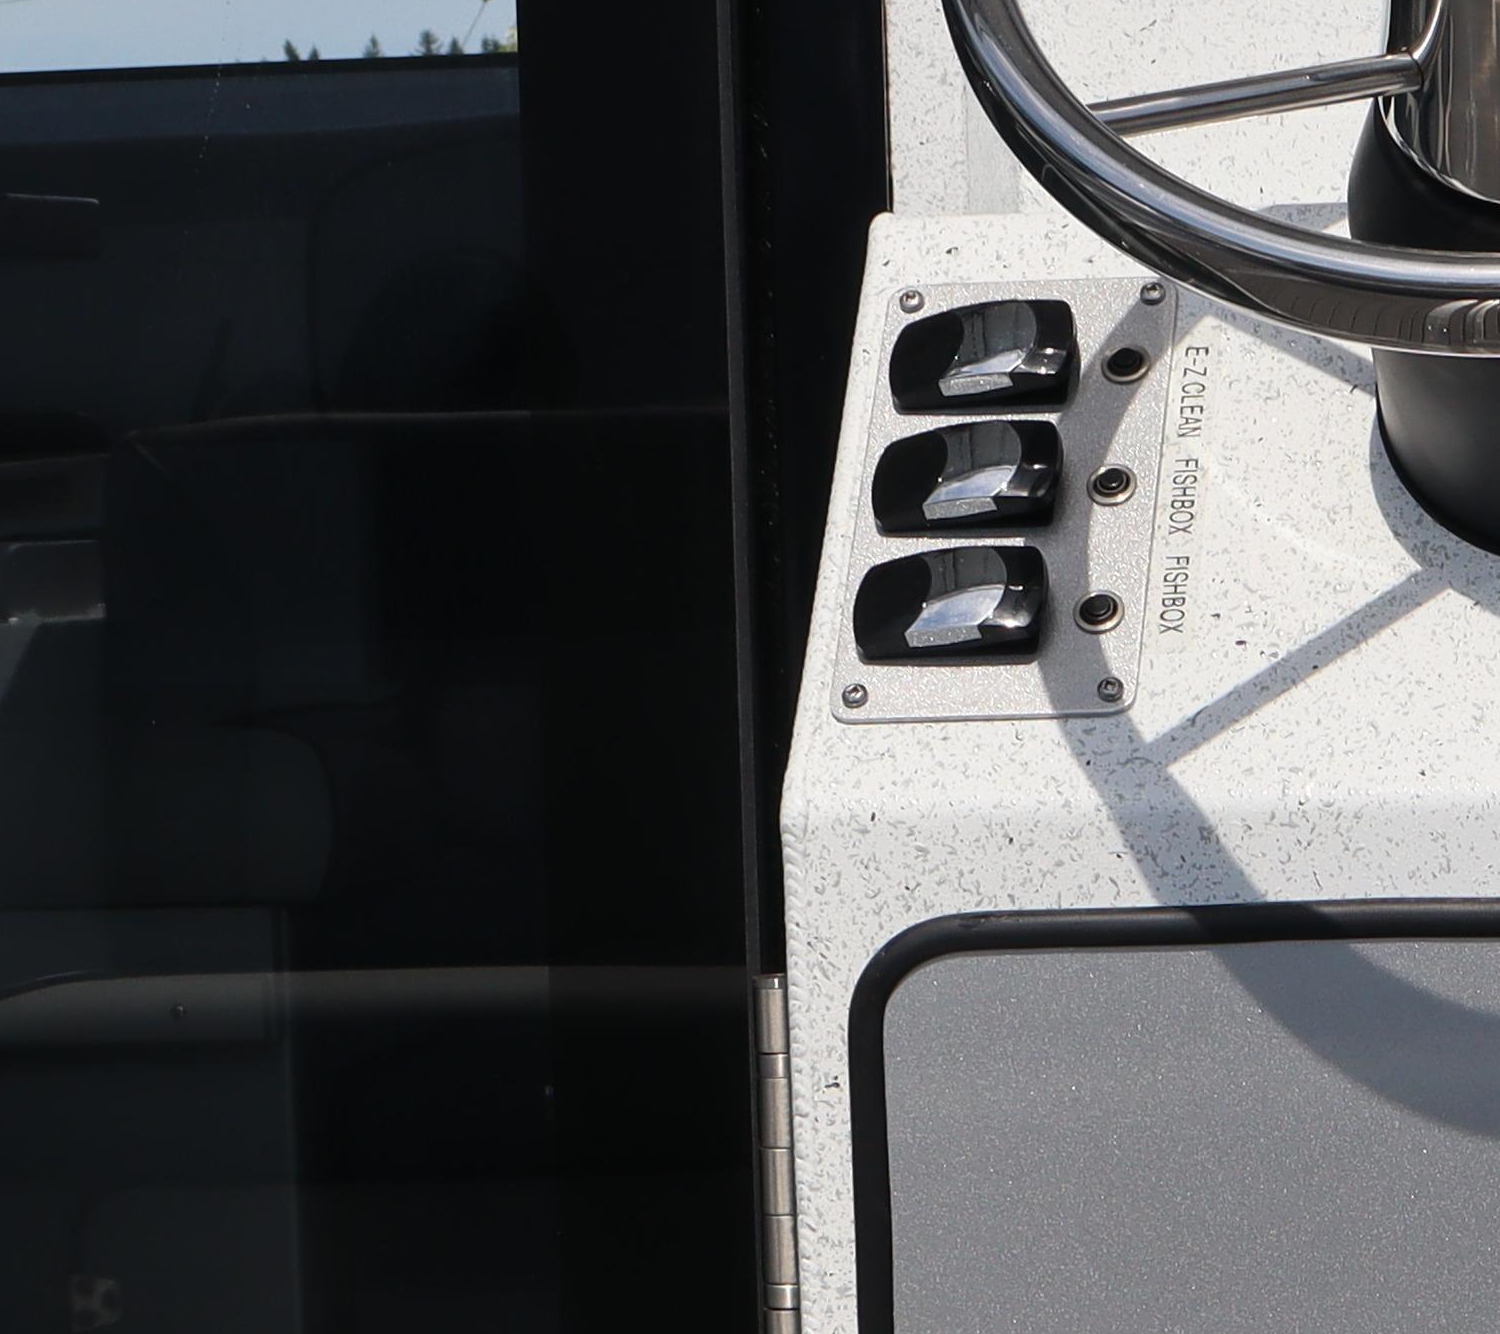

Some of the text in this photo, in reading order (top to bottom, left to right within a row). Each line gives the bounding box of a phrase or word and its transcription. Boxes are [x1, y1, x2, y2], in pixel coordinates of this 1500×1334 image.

[1158, 345, 1210, 636] E-Z CLEAN FISHBOX FISHBOX
